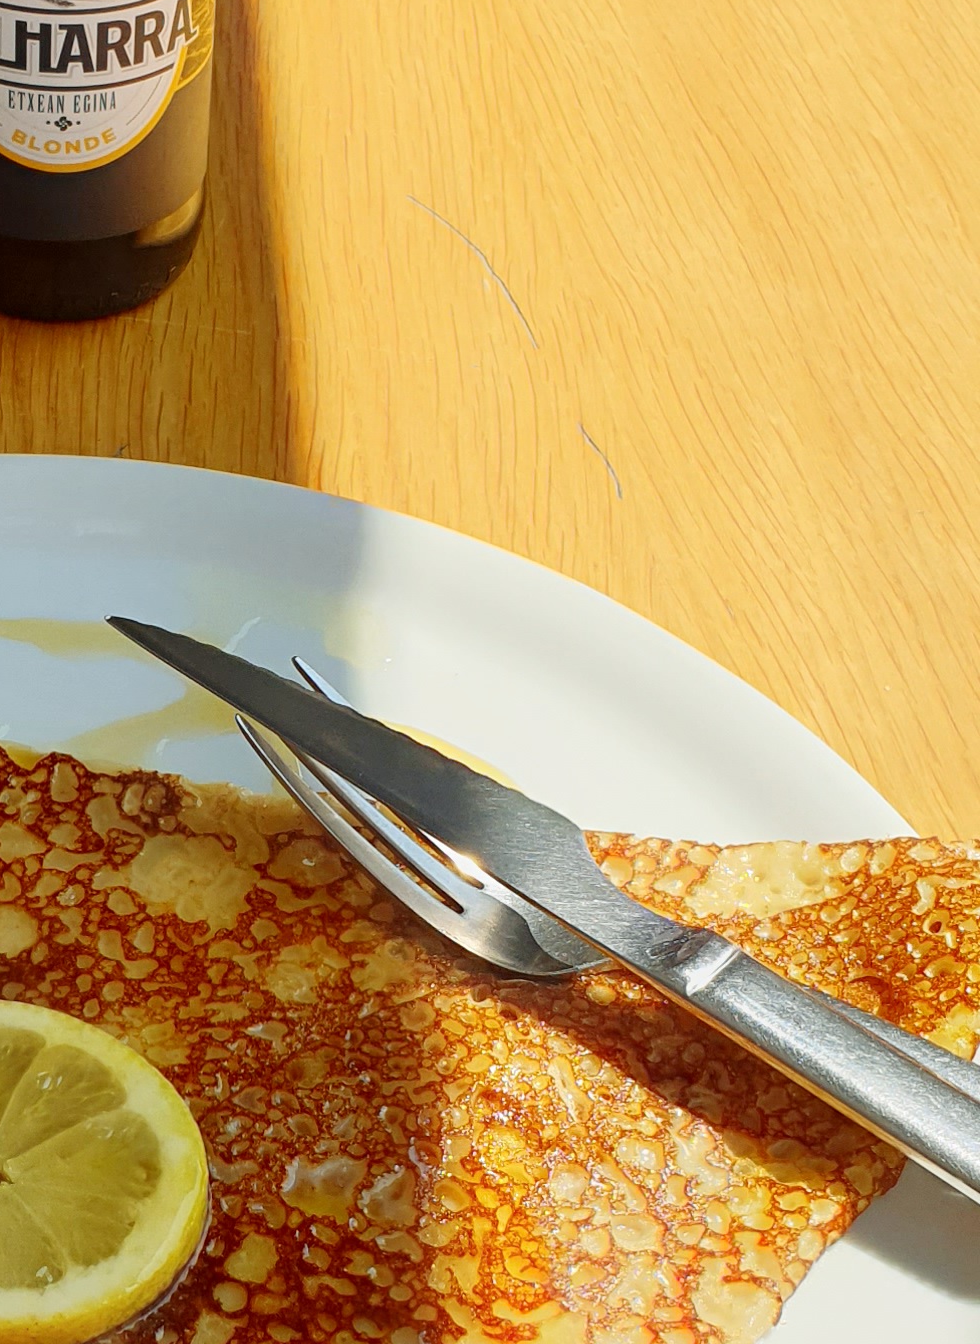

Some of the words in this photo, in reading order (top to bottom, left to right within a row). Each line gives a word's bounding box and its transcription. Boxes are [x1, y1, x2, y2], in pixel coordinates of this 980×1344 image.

[8, 89, 65, 114] ETXEAN
[73, 91, 117, 114] EGINA
[11, 127, 117, 154] BLONDE
